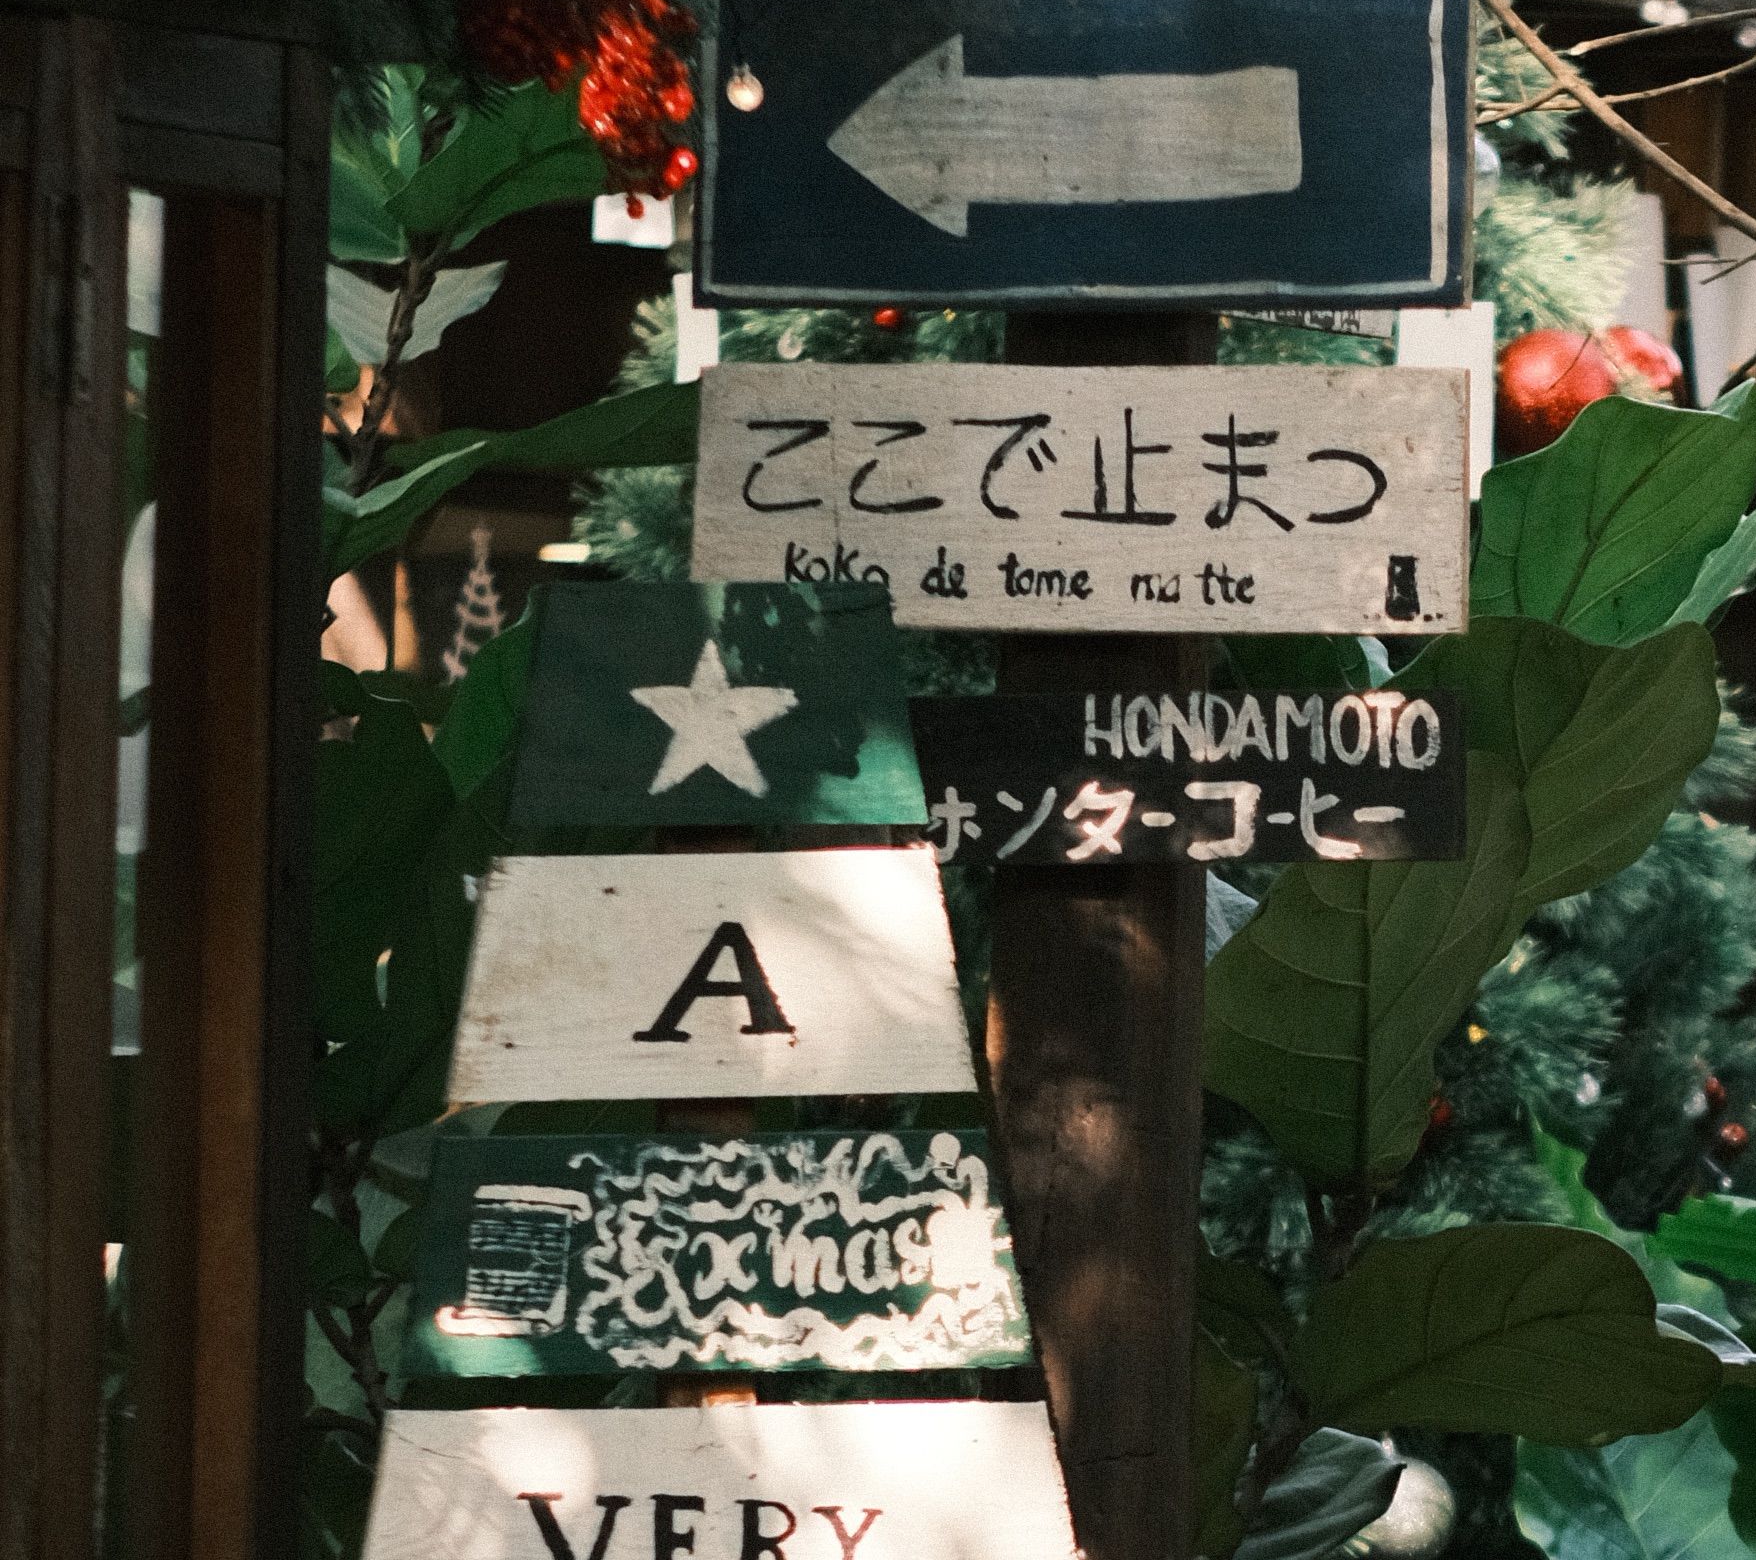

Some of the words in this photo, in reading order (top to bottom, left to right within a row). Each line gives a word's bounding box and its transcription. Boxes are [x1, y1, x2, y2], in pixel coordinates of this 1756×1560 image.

[920, 546, 968, 599] de
[997, 552, 1094, 600] tome
[1084, 691, 1441, 770] HONDAMOTO
[632, 920, 797, 1043] A
